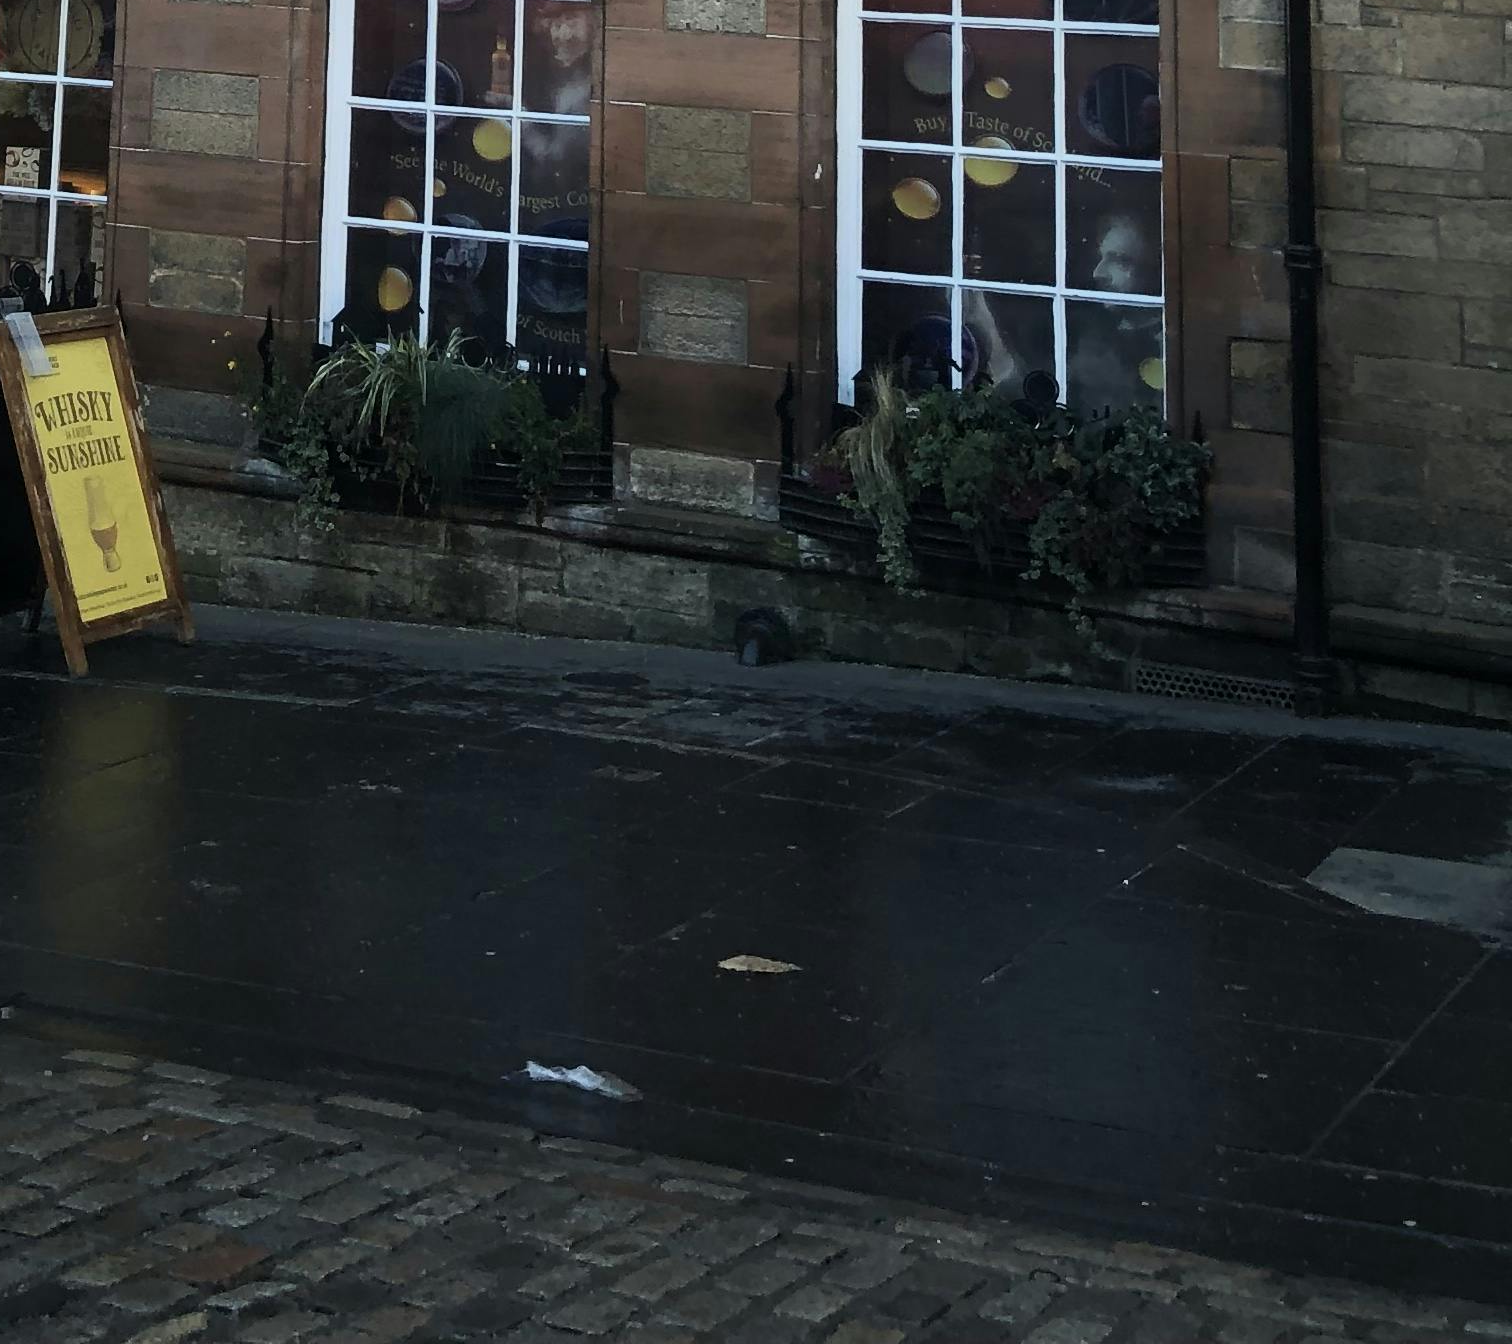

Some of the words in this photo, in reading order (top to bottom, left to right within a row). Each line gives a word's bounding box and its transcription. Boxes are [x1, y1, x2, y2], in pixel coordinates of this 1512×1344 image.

[913, 116, 947, 134] Buy
[965, 111, 1010, 135] Taste
[1013, 126, 1034, 142] of
[453, 160, 504, 198] World's
[519, 193, 561, 213] argest
[533, 319, 582, 345] Scotch
[34, 390, 114, 433] WHISKY
[46, 434, 126, 475] SUNSHINE
